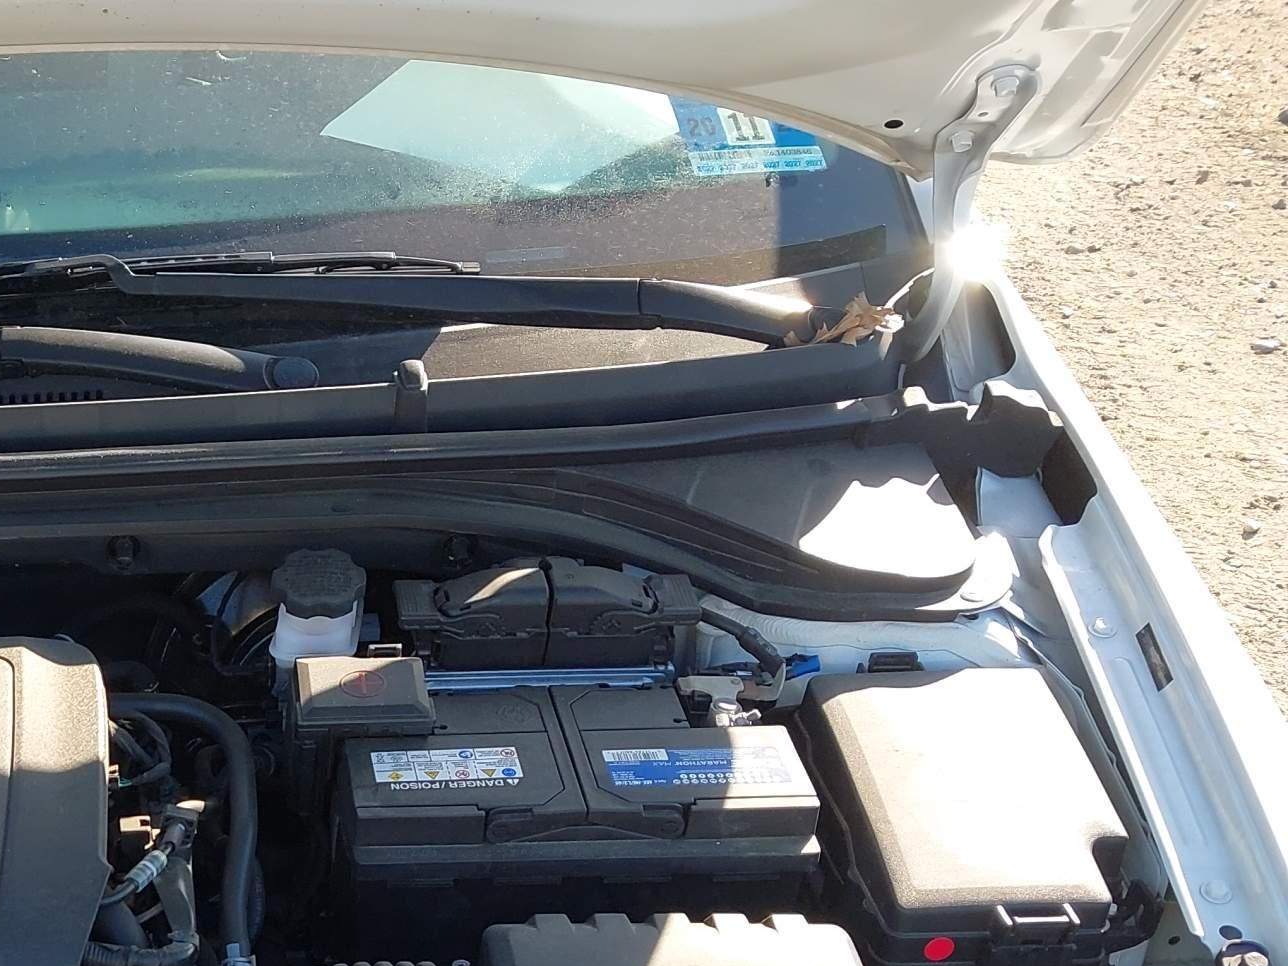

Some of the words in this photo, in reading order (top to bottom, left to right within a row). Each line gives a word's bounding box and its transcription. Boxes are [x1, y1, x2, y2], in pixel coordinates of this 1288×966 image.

[727, 112, 765, 141] 11
[390, 781, 440, 791] POISON
[448, 779, 505, 789] DANGER
